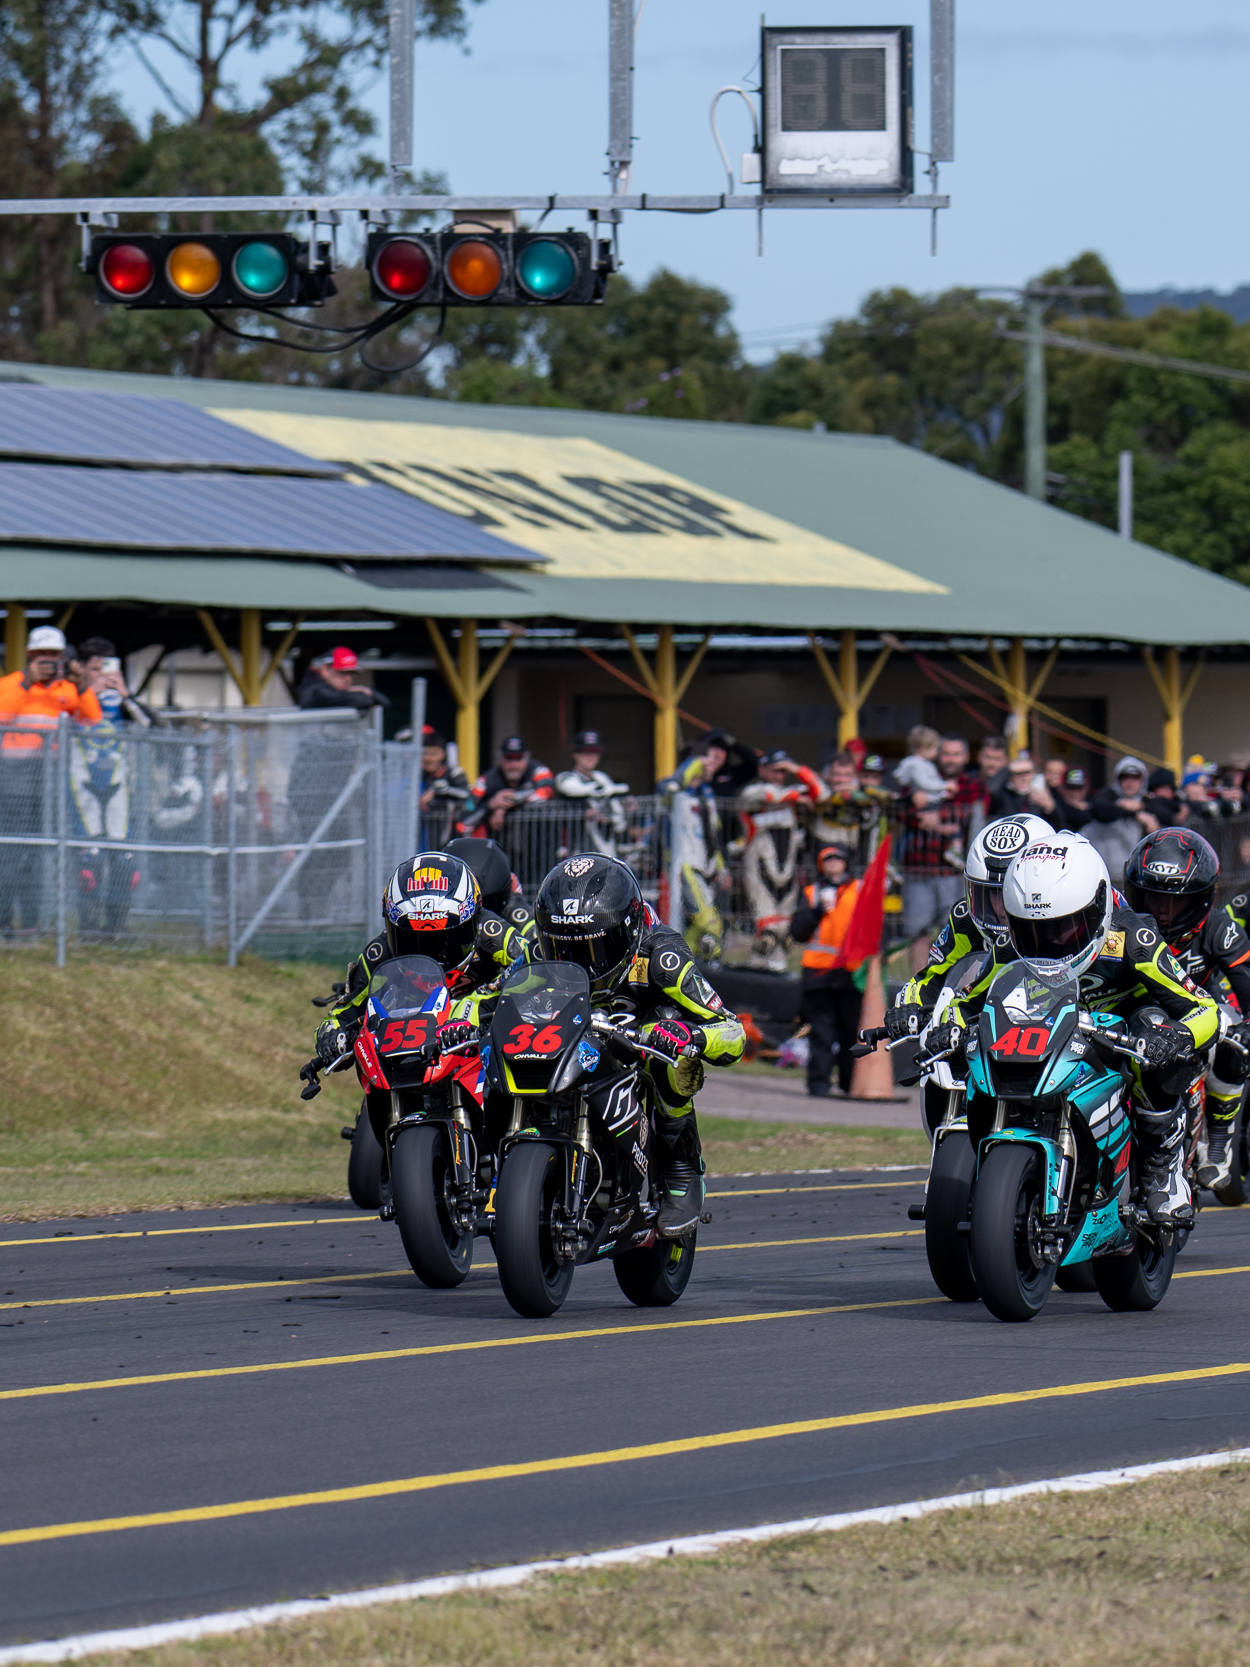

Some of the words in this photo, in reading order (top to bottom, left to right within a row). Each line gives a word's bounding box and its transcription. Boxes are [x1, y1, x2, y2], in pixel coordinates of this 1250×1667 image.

[323, 459, 779, 544] UNLOP
[992, 825, 1021, 838] HEAD
[990, 837, 1018, 850] SOX
[1021, 846, 1068, 859] land
[1148, 862, 1180, 875] KYT
[407, 910, 450, 921] SHARK
[550, 914, 595, 924] SHARK
[584, 931, 607, 940] BRAVE.
[380, 1019, 428, 1053] 55
[503, 1024, 562, 1054] 36
[990, 1027, 1051, 1056] 40
[1114, 1141, 1131, 1175] 40
